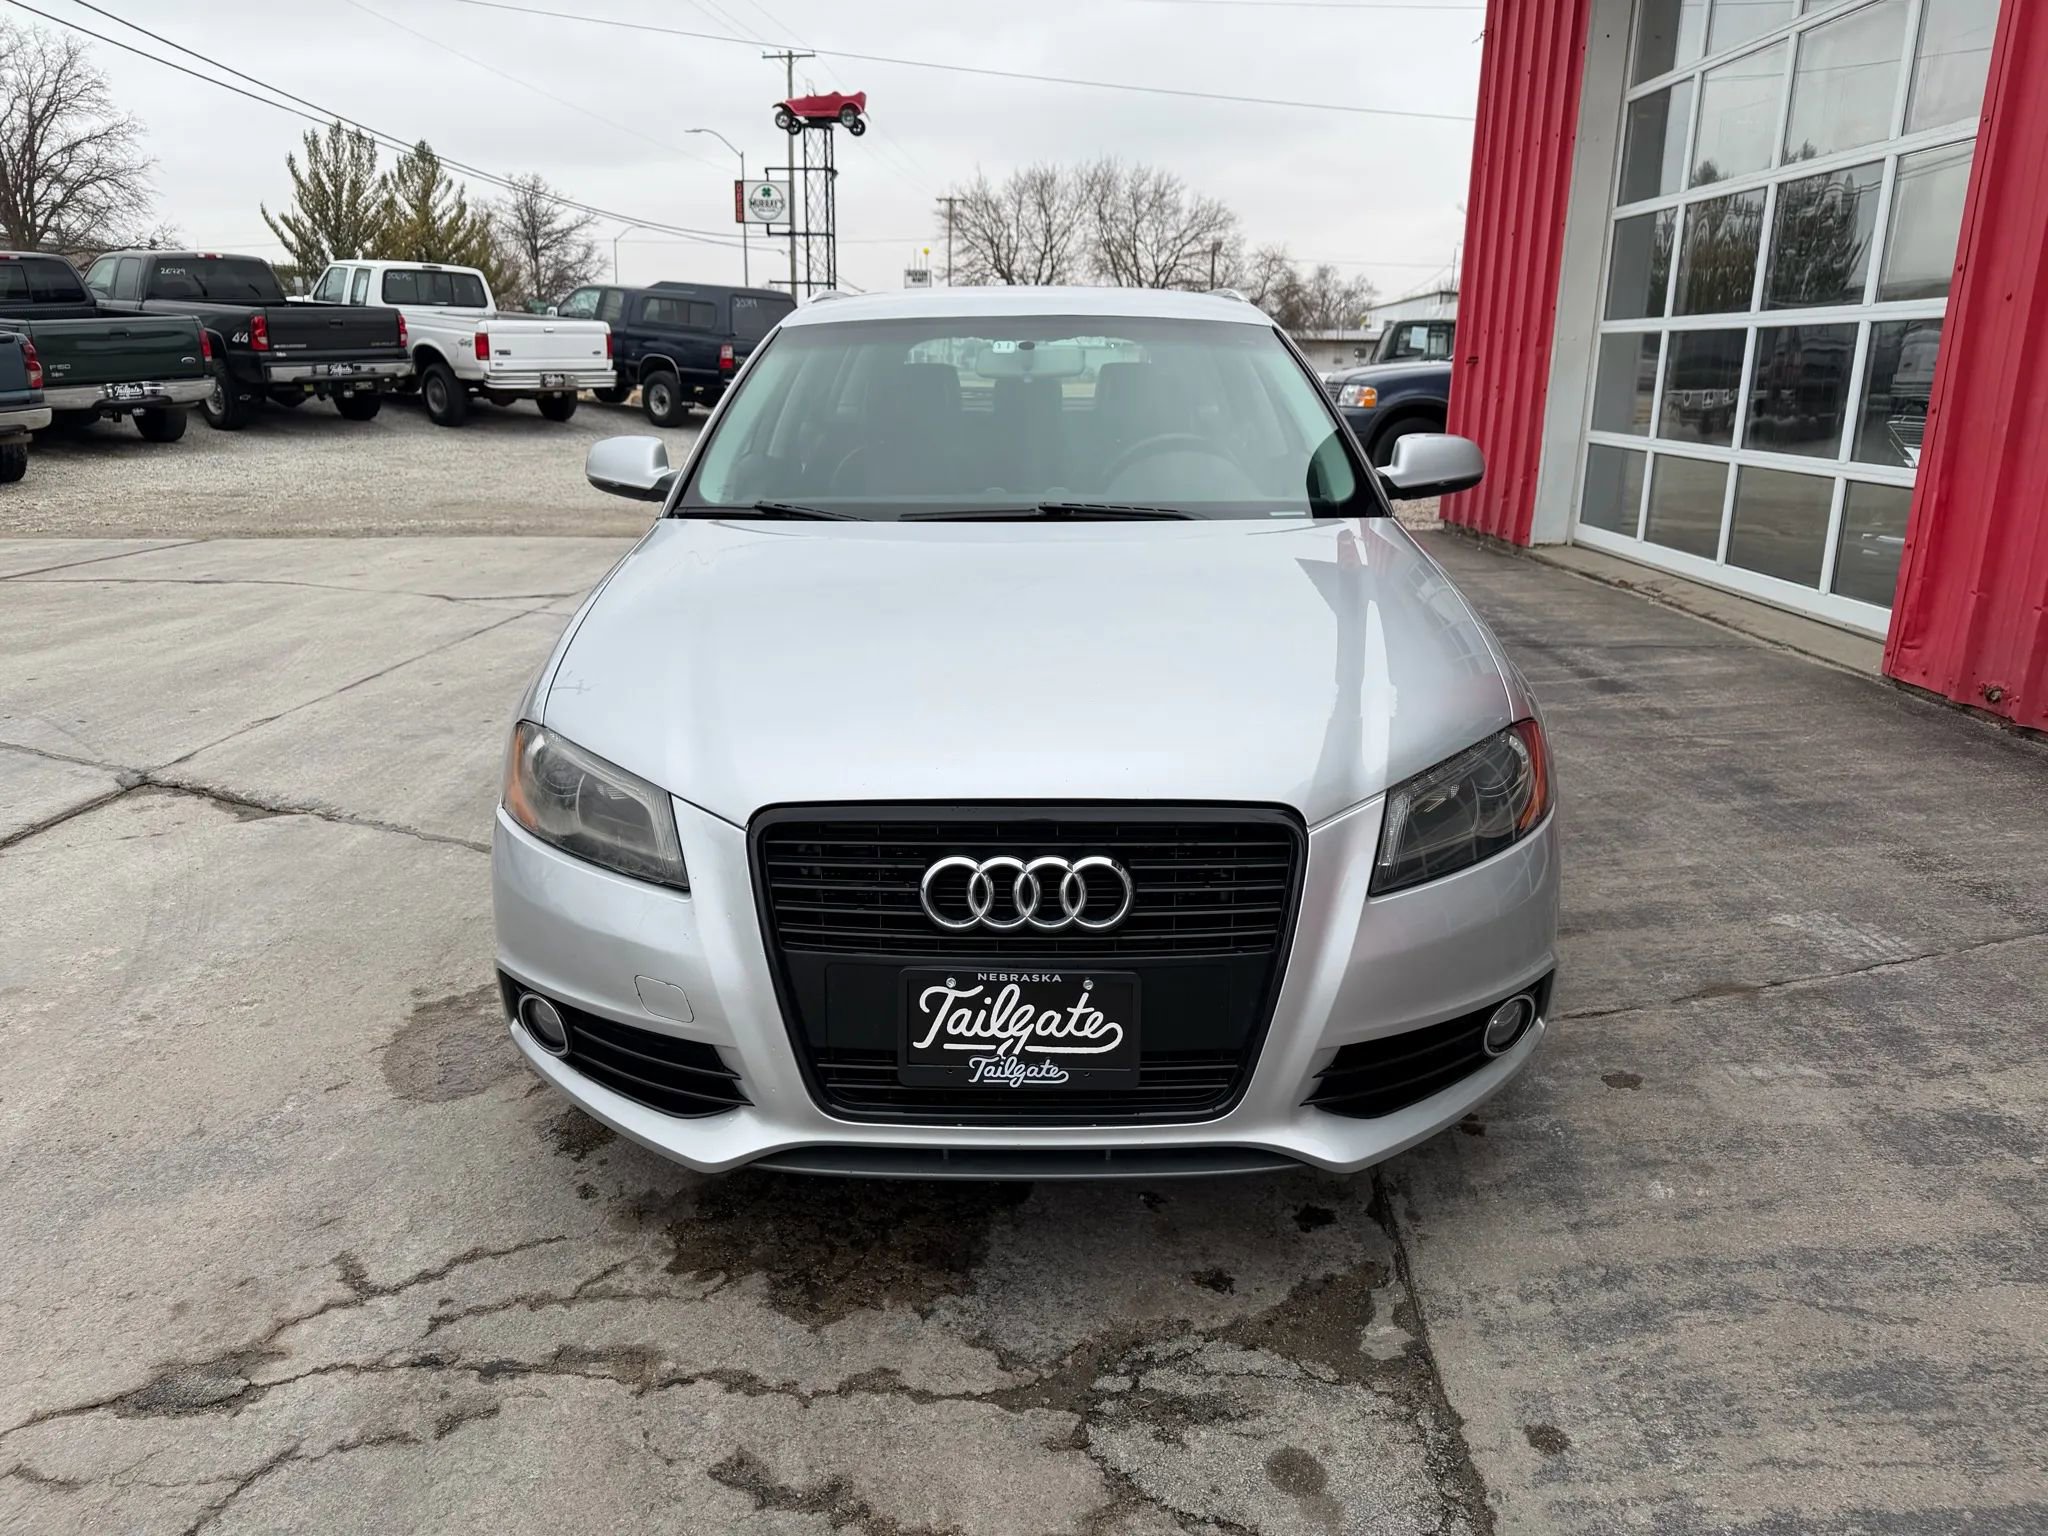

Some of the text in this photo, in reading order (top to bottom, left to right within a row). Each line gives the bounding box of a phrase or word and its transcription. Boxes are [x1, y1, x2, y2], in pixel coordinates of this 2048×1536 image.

[977, 973, 1062, 983] NEBRASKA
[912, 984, 1124, 1056] Tailgate
[968, 1056, 1069, 1088] Tailgate
